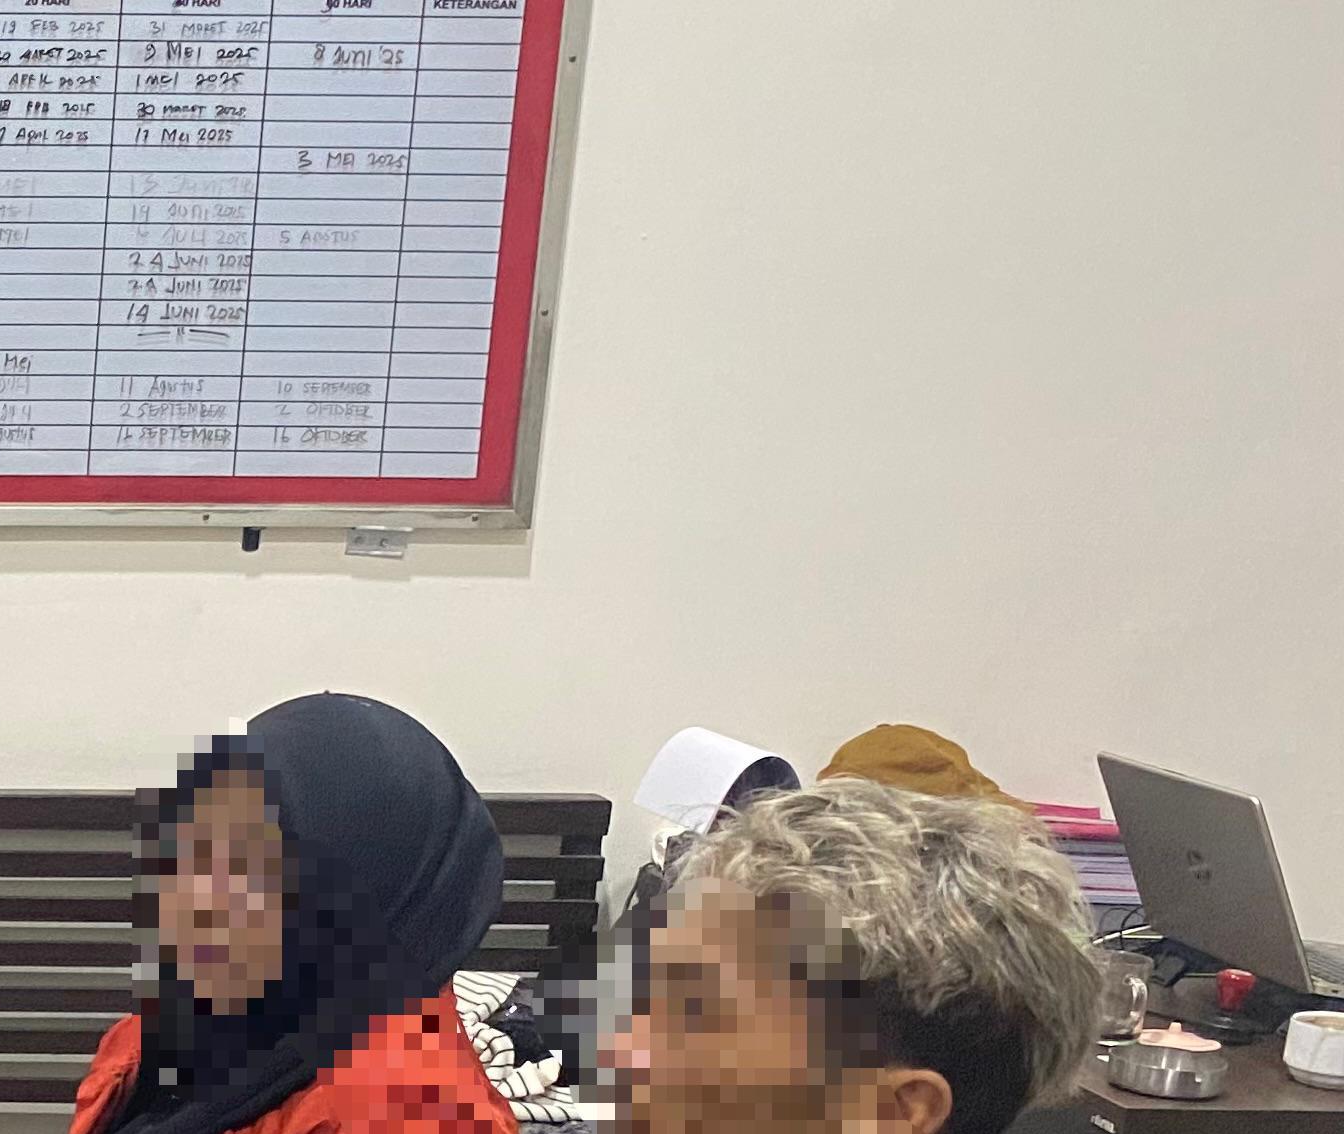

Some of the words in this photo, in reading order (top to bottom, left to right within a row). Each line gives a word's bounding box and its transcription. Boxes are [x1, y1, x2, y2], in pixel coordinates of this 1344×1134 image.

[434, 0, 517, 9] KETERANGAN
[69, 21, 105, 33] 2025
[66, 48, 108, 62] 2025
[216, 46, 259, 61] 2025
[196, 71, 245, 88] 2025
[197, 128, 234, 142] 2025
[298, 151, 313, 168] 3
[367, 153, 407, 169] 2025
[159, 302, 200, 321] JUNI
